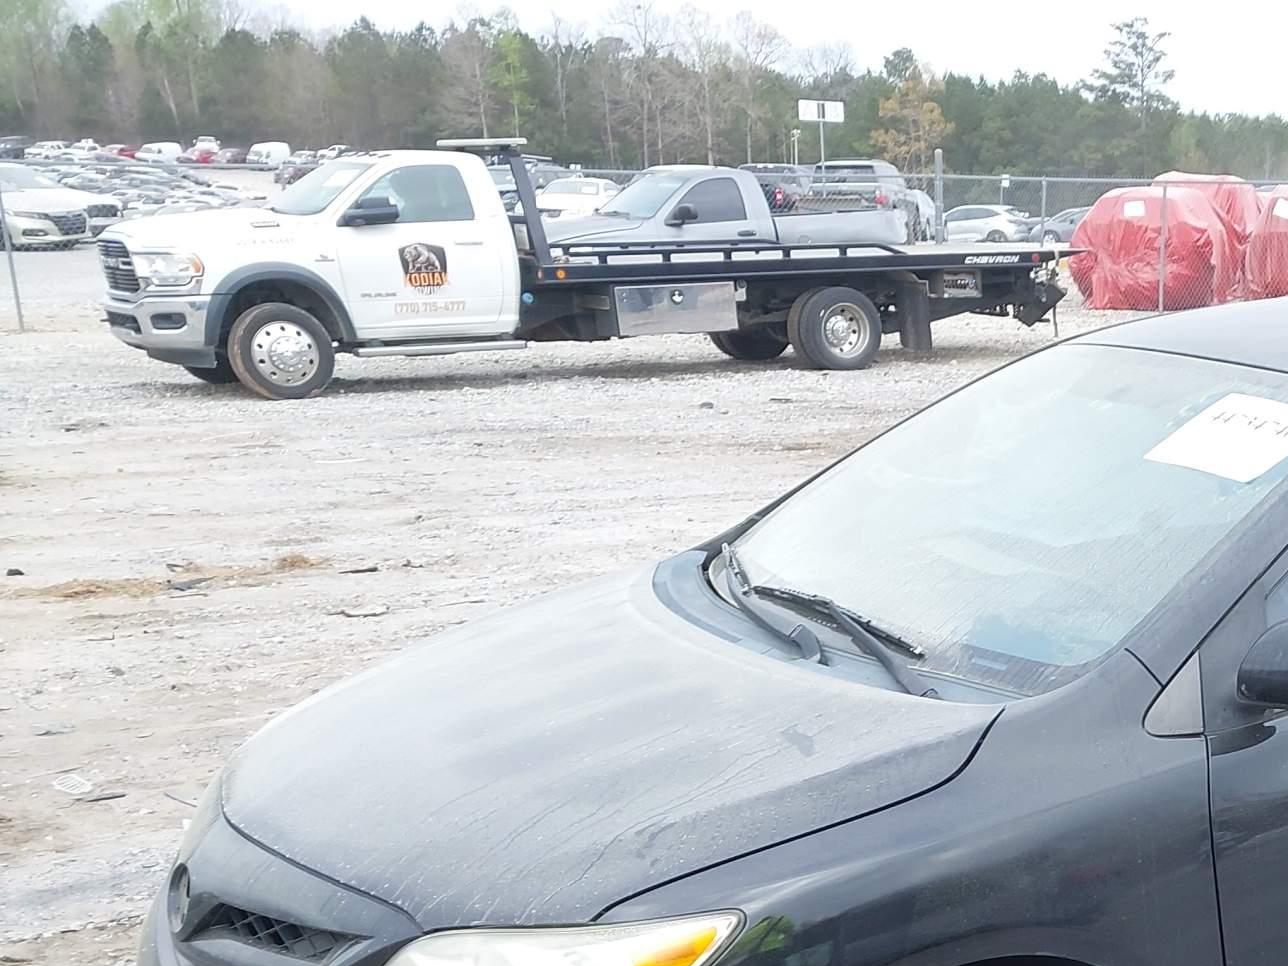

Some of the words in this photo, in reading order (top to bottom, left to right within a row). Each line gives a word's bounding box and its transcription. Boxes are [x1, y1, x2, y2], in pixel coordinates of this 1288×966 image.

[964, 255, 1020, 264] CHEVRON
[403, 271, 449, 287] KODIAK
[394, 303, 420, 314] (770)
[422, 301, 466, 313] 715-4777
